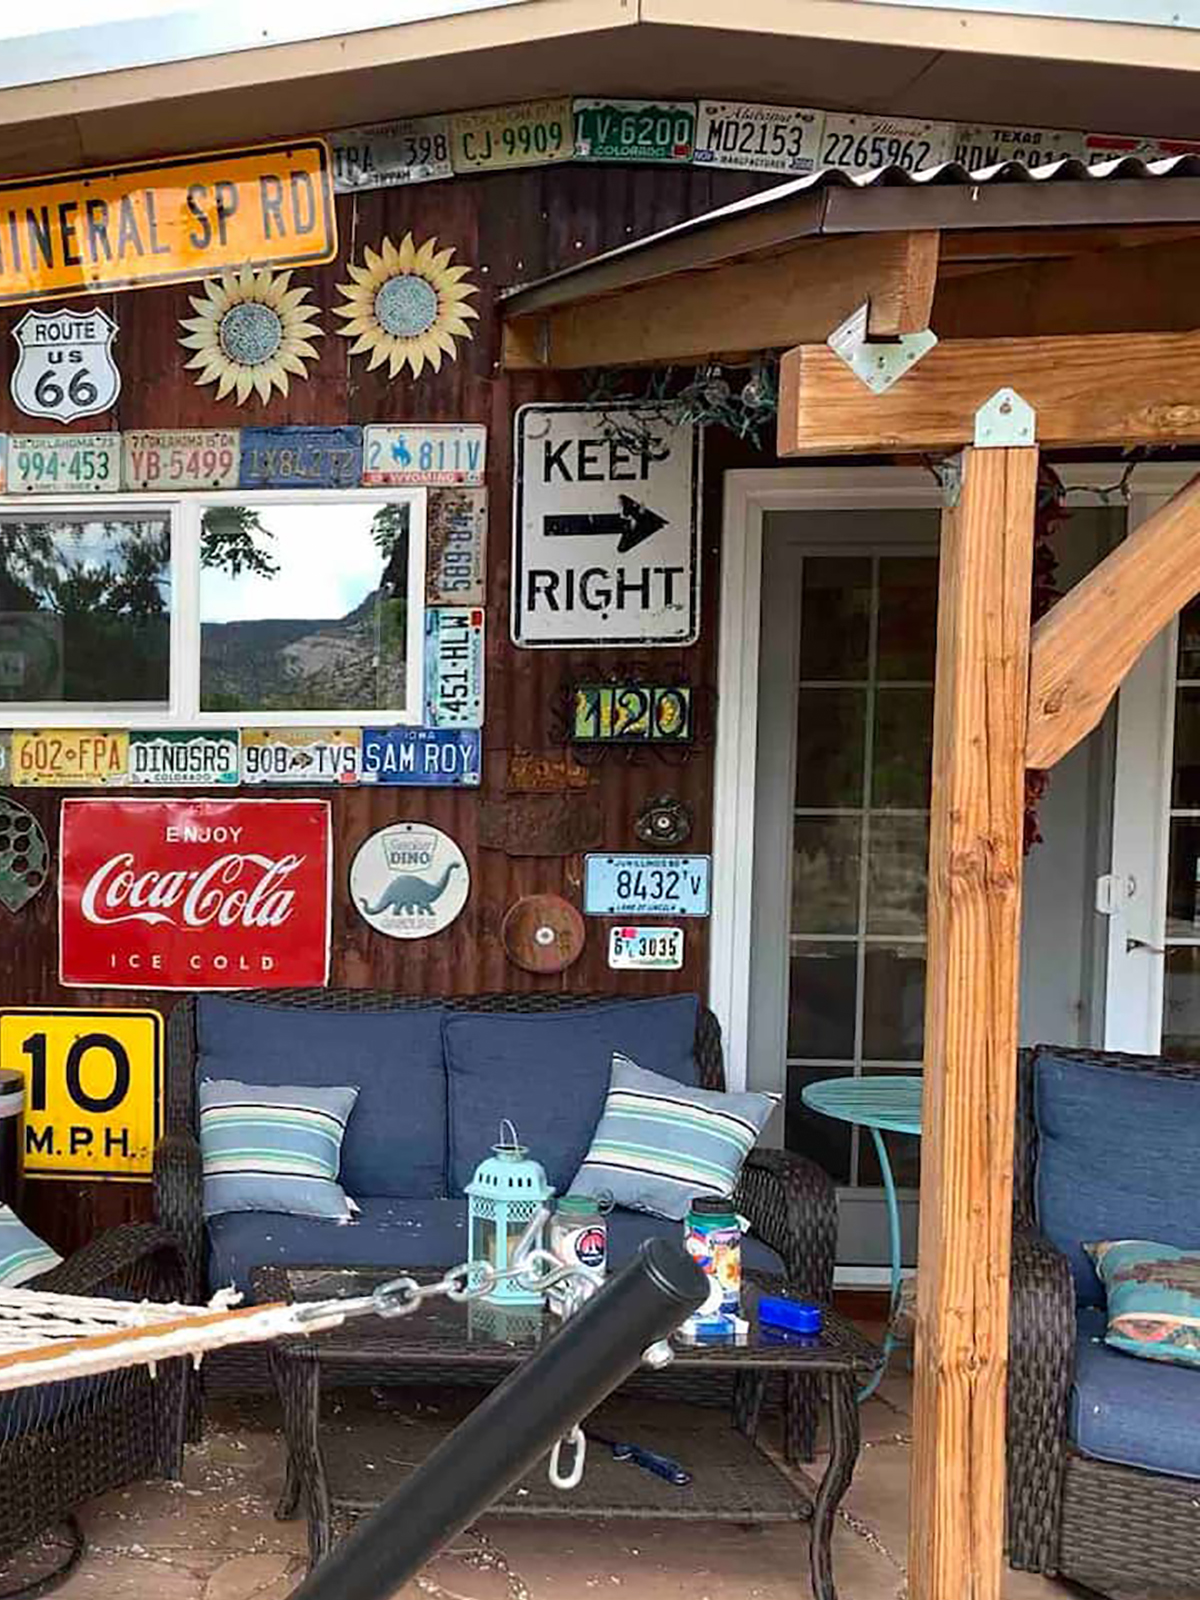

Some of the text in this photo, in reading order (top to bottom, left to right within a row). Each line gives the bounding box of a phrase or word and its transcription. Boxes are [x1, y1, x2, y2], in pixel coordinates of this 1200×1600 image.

[403, 133, 447, 166] 398
[992, 130, 1043, 145] TEXAS
[184, 180, 241, 250] SP
[258, 168, 317, 242] RD
[35, 321, 96, 342] ROUTE
[35, 368, 98, 408] 66
[543, 437, 671, 483] KEEP
[527, 567, 685, 612] RIGHT
[19, 739, 121, 771] 602 FPA
[315, 745, 357, 774] TVS
[366, 742, 415, 773] SAM
[423, 742, 473, 774] ROY
[154, 773, 212, 782] COLORADO
[166, 826, 243, 844] ENJOY
[390, 851, 430, 865] DINO
[616, 869, 680, 901] 8432
[110, 954, 276, 971] ICE COLD
[638, 936, 677, 957] 3035
[21, 1032, 131, 1114] 10
[25, 1125, 137, 1159] M.P.H.
